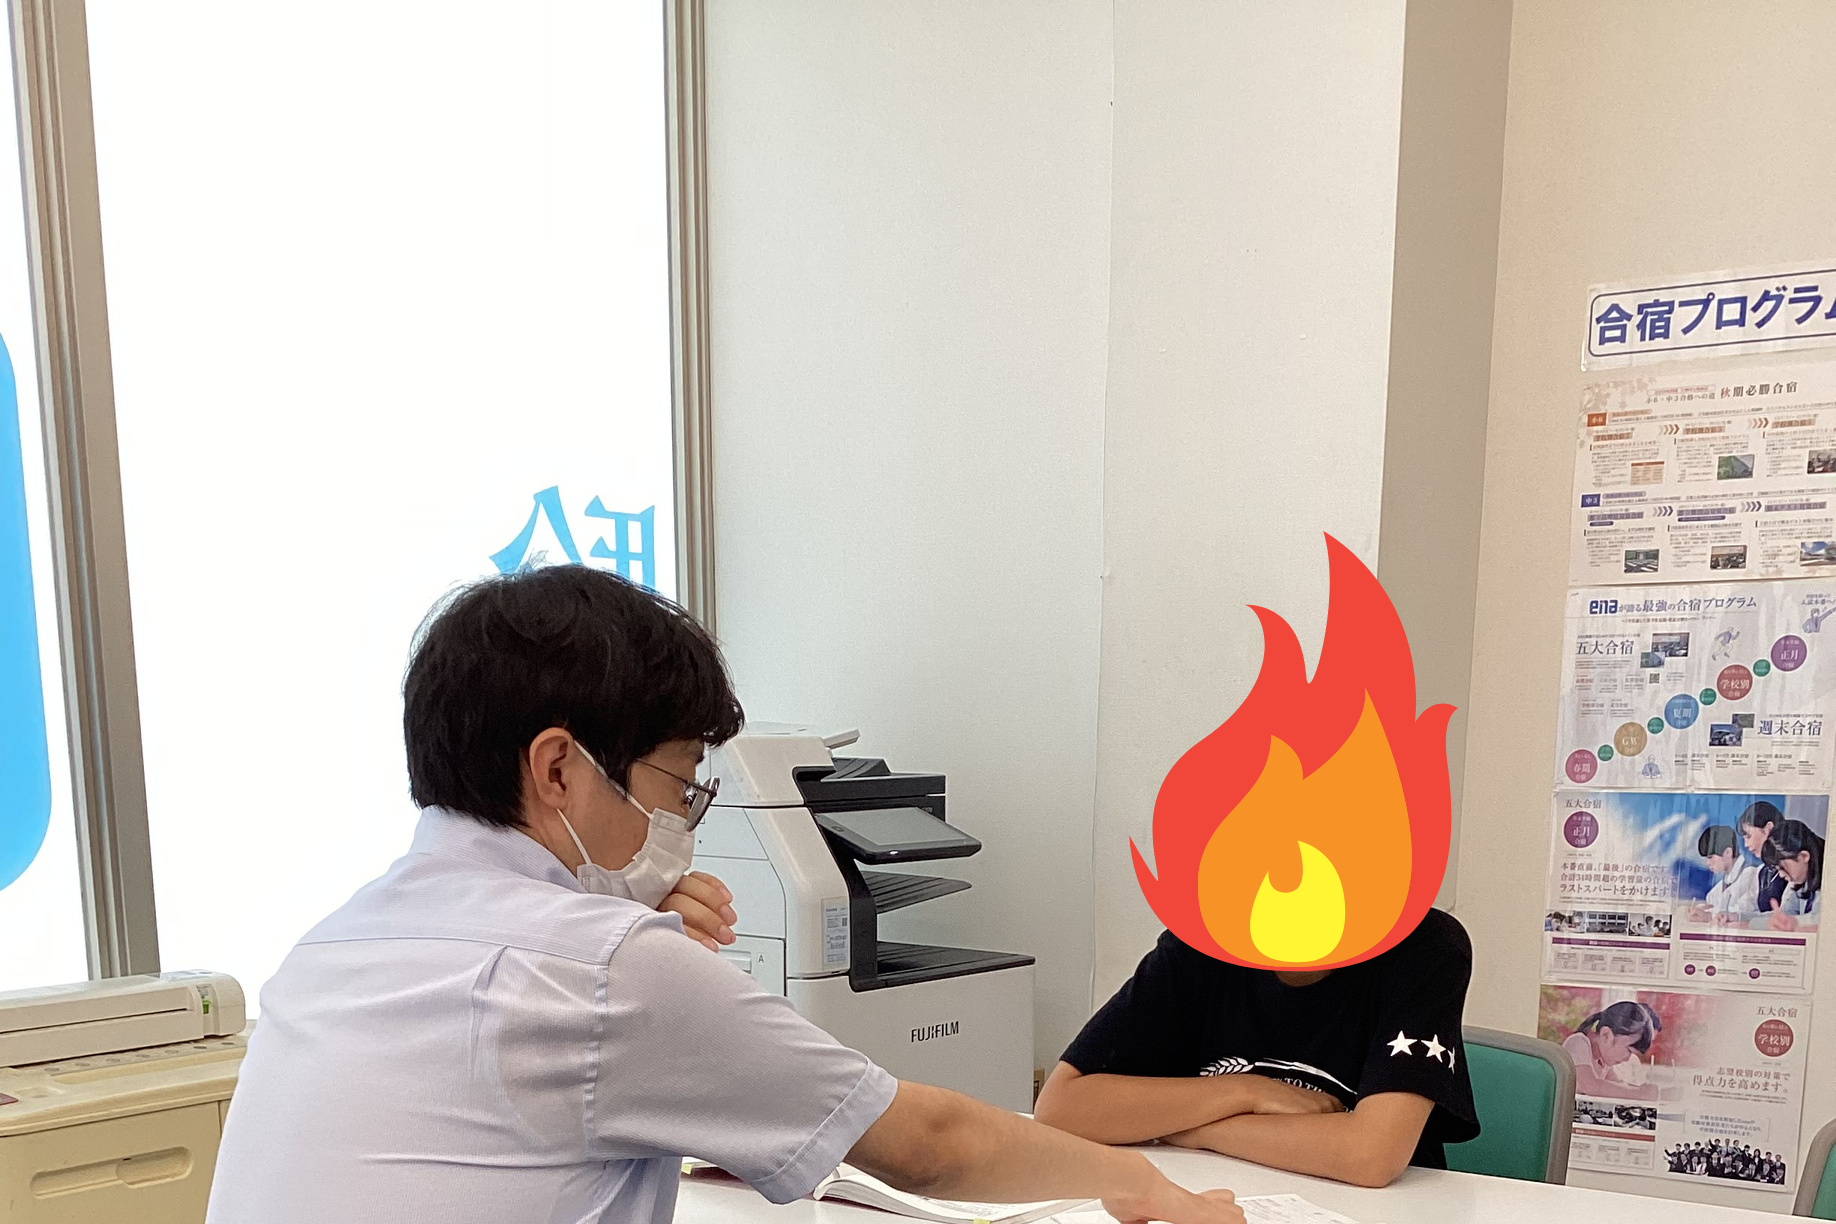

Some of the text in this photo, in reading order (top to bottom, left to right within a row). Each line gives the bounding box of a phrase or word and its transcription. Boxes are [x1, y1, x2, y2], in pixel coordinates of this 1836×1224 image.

[1720, 381, 1798, 399] 秋期必勝合宿
[1576, 640, 1635, 655] 五大合宿
[1757, 720, 1823, 736] 週末合宿
[1565, 798, 1602, 809] 五大合宿
[1756, 1006, 1798, 1018] 五大合宿
[911, 1021, 959, 1043] FUJIFILM
[1758, 1033, 1791, 1046] 学校別
[1693, 1074, 1788, 1093] 得点力を高めます。
